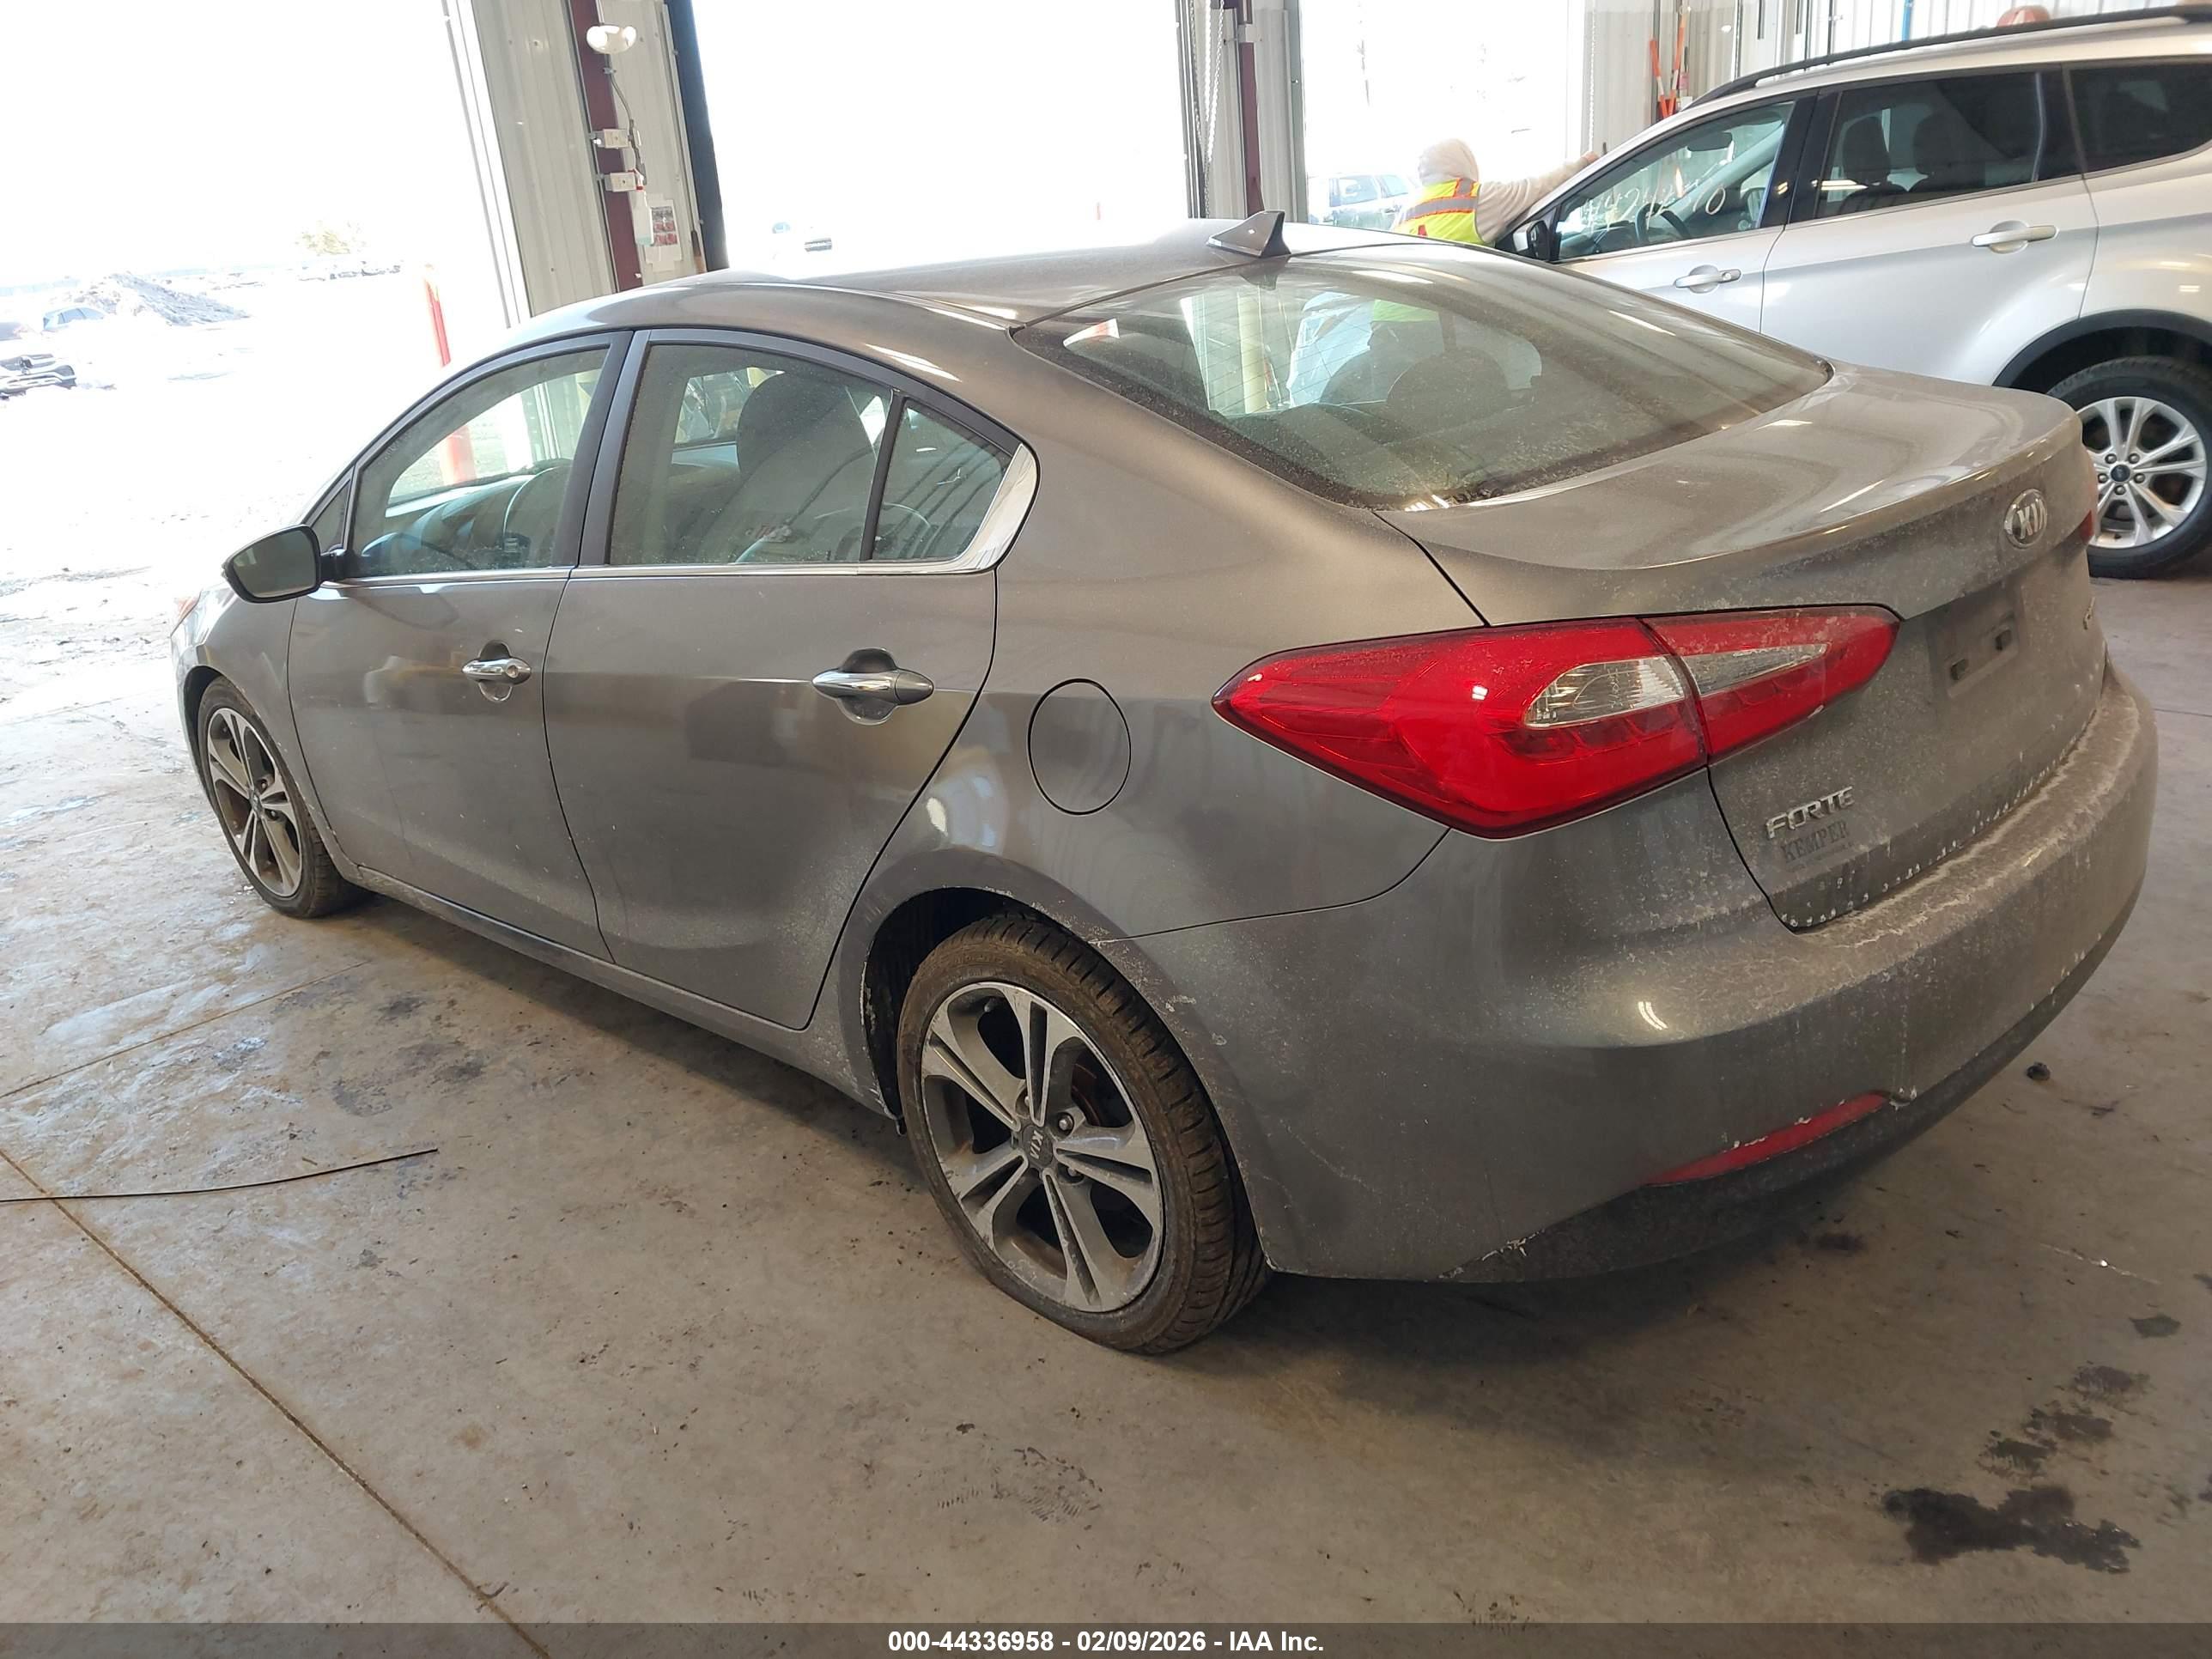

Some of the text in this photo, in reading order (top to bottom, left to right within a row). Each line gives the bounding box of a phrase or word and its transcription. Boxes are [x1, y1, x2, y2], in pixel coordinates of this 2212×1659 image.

[1765, 786, 1856, 839] FORTE
[1781, 819, 1848, 861] KEMPER
[1030, 1129, 1043, 1159] KIA
